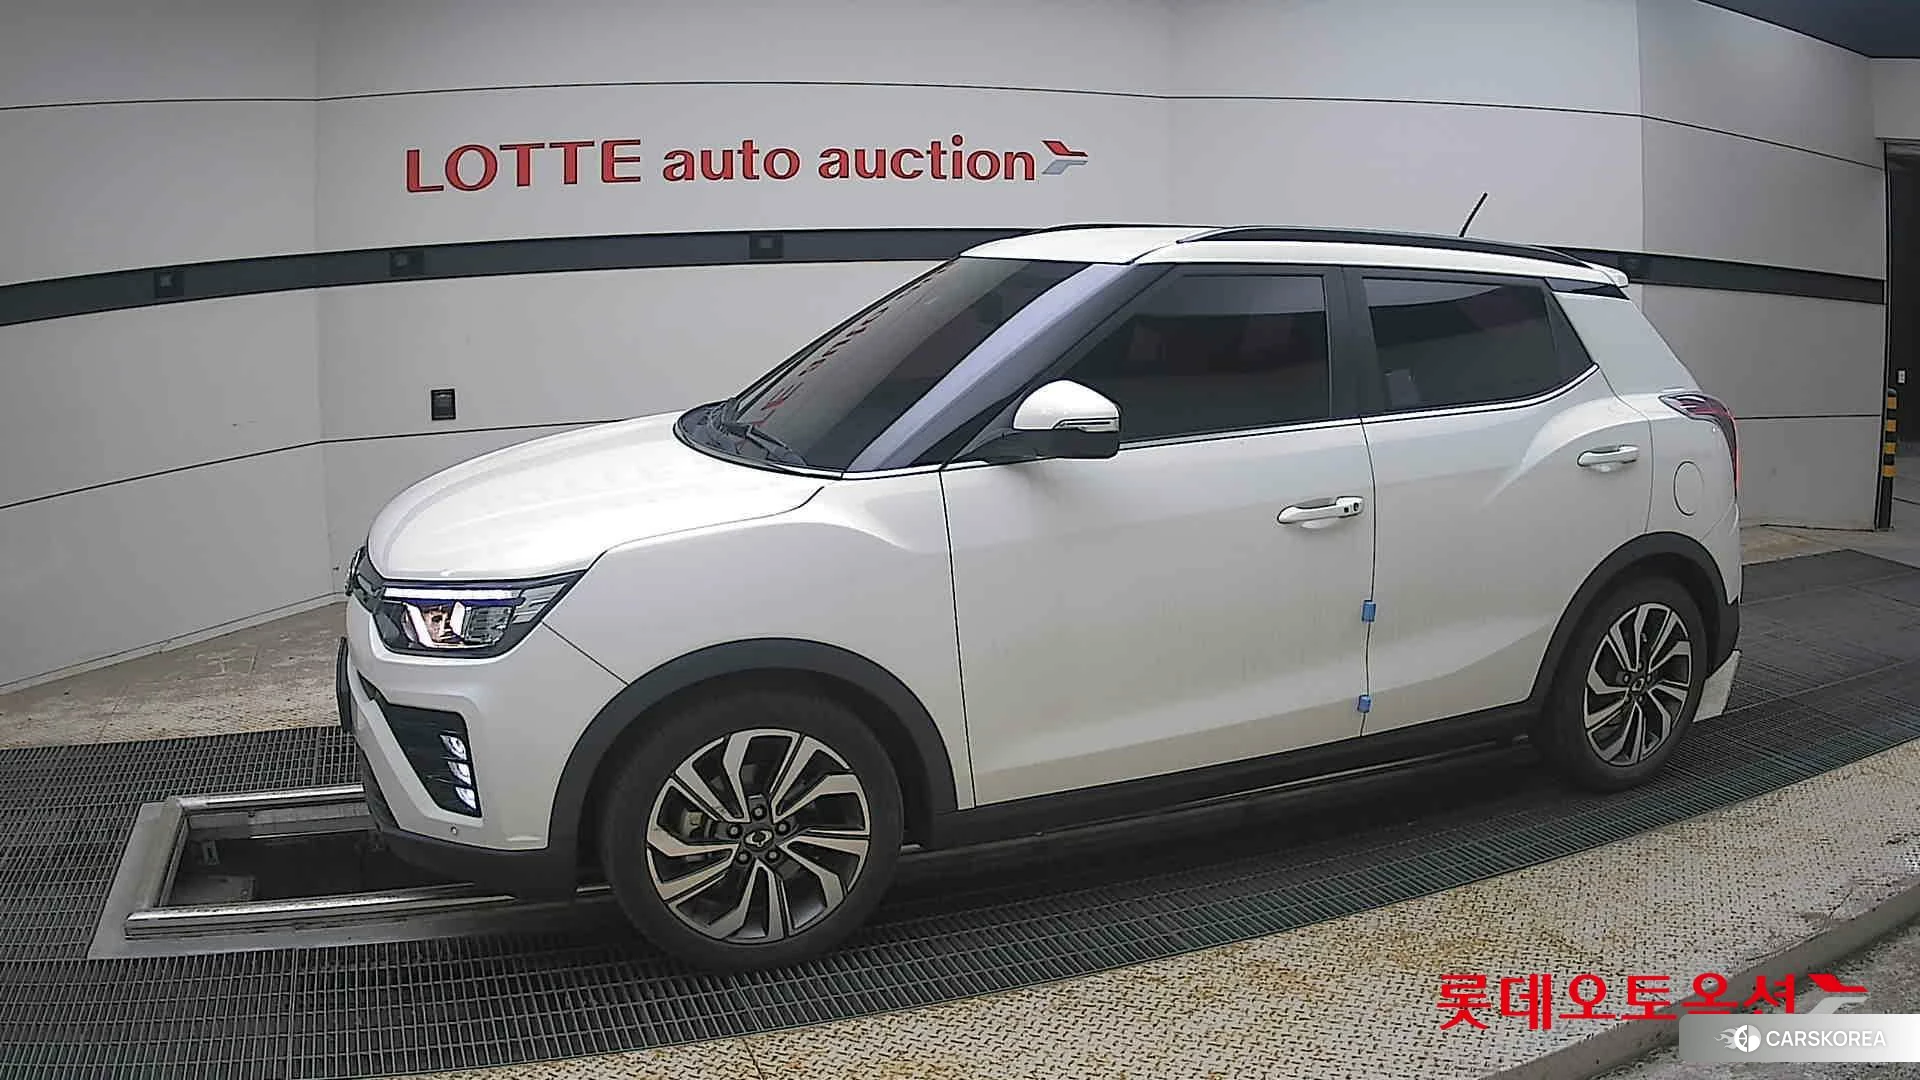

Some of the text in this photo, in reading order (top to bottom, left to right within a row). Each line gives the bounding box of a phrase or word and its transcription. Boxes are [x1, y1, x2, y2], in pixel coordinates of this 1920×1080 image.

[406, 135, 1036, 193] LOTTE auto auction
